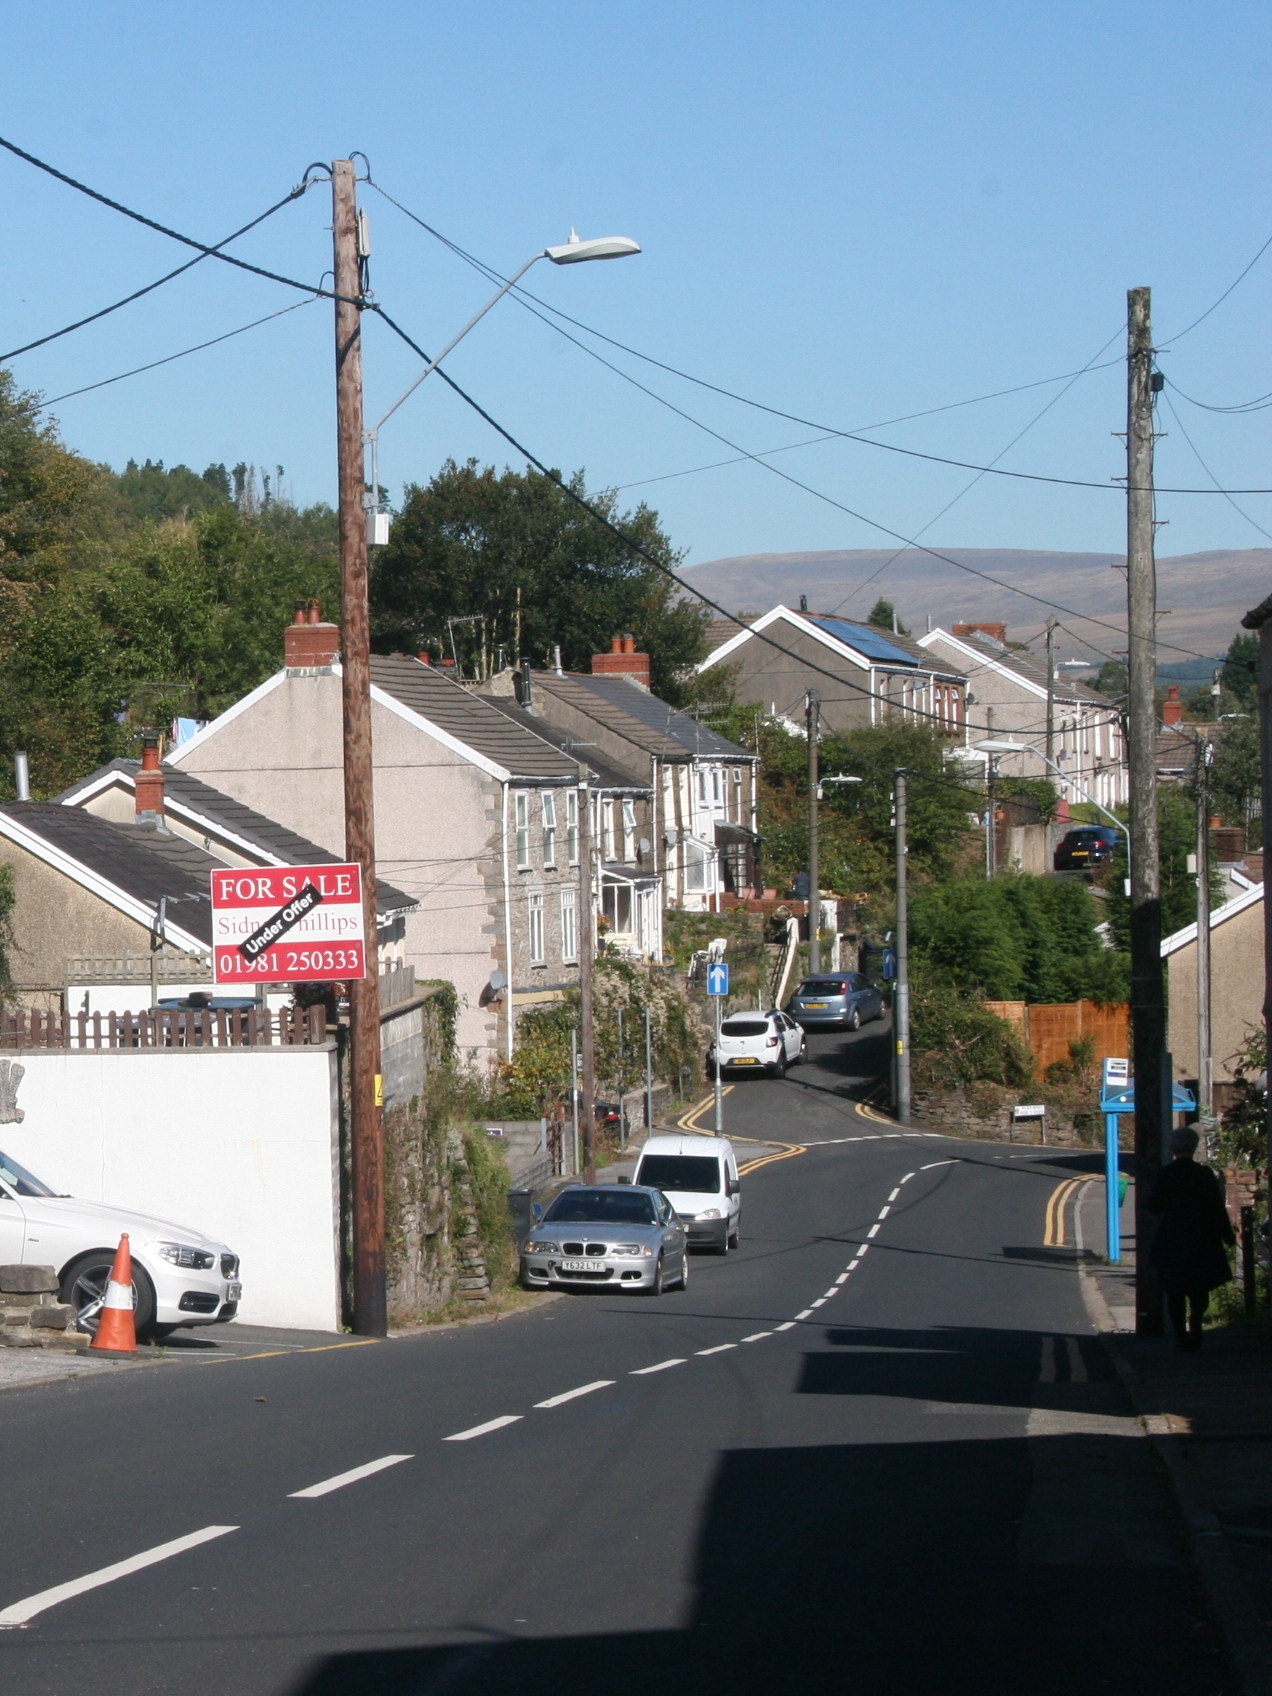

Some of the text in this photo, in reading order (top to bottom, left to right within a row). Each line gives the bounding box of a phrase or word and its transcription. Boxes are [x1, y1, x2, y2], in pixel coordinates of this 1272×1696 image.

[219, 877, 275, 900] FOR
[245, 892, 314, 954] Under Offer
[287, 912, 358, 935] hillips
[220, 949, 359, 973] 01981 250333
[565, 1261, 585, 1270] Y632
